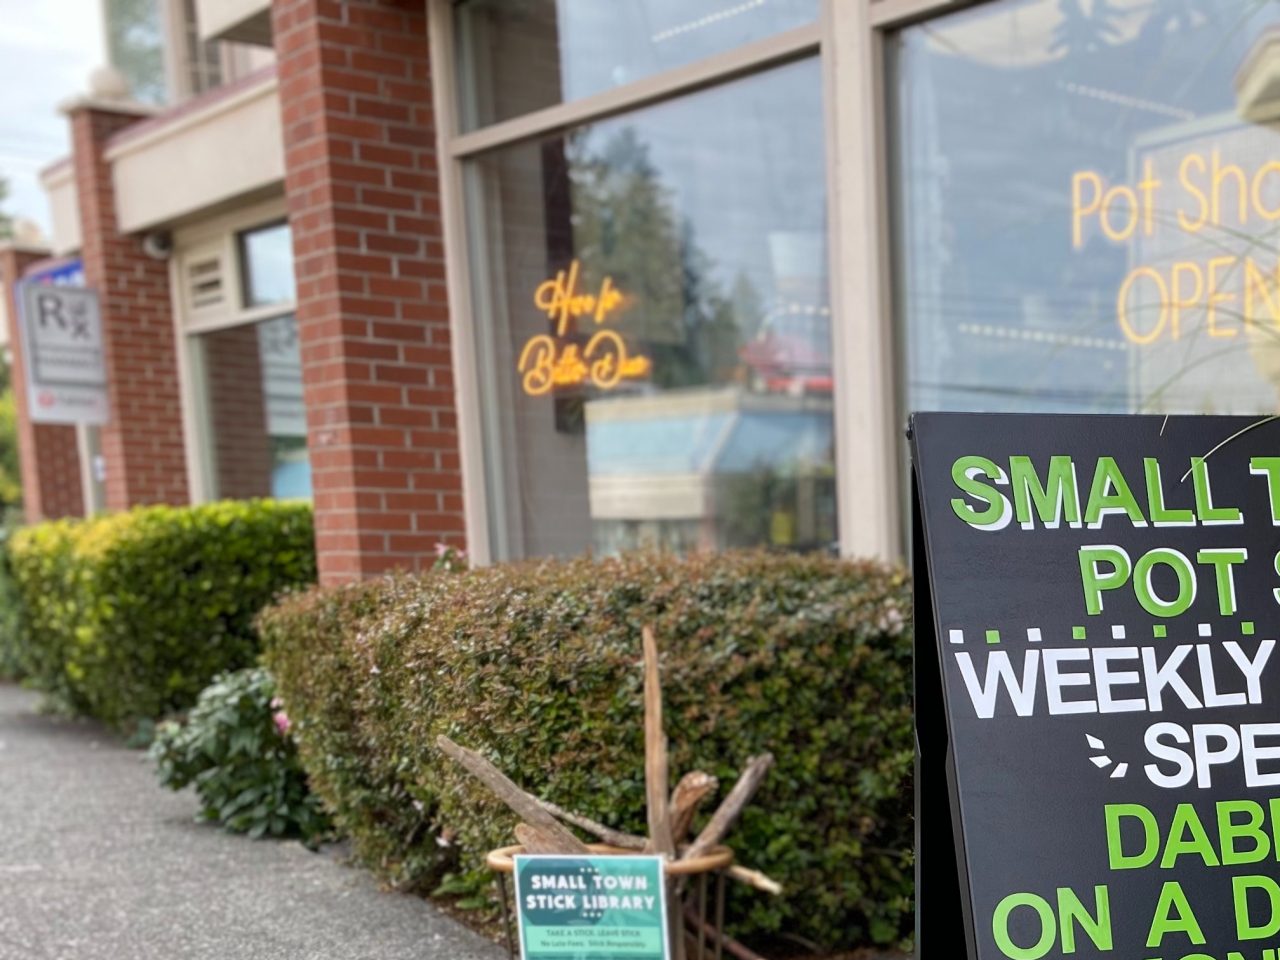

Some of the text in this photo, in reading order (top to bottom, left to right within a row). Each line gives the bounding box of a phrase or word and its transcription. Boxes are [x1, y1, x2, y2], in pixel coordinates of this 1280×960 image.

[1070, 156, 1161, 248] Pot
[950, 455, 1244, 531] SMALL
[1078, 544, 1248, 617] POT
[954, 640, 1276, 719] WEEKLY
[526, 895, 655, 909] STICK LIBRARY
[531, 875, 647, 890] SMALL TOWN
[1146, 881, 1206, 948] A
